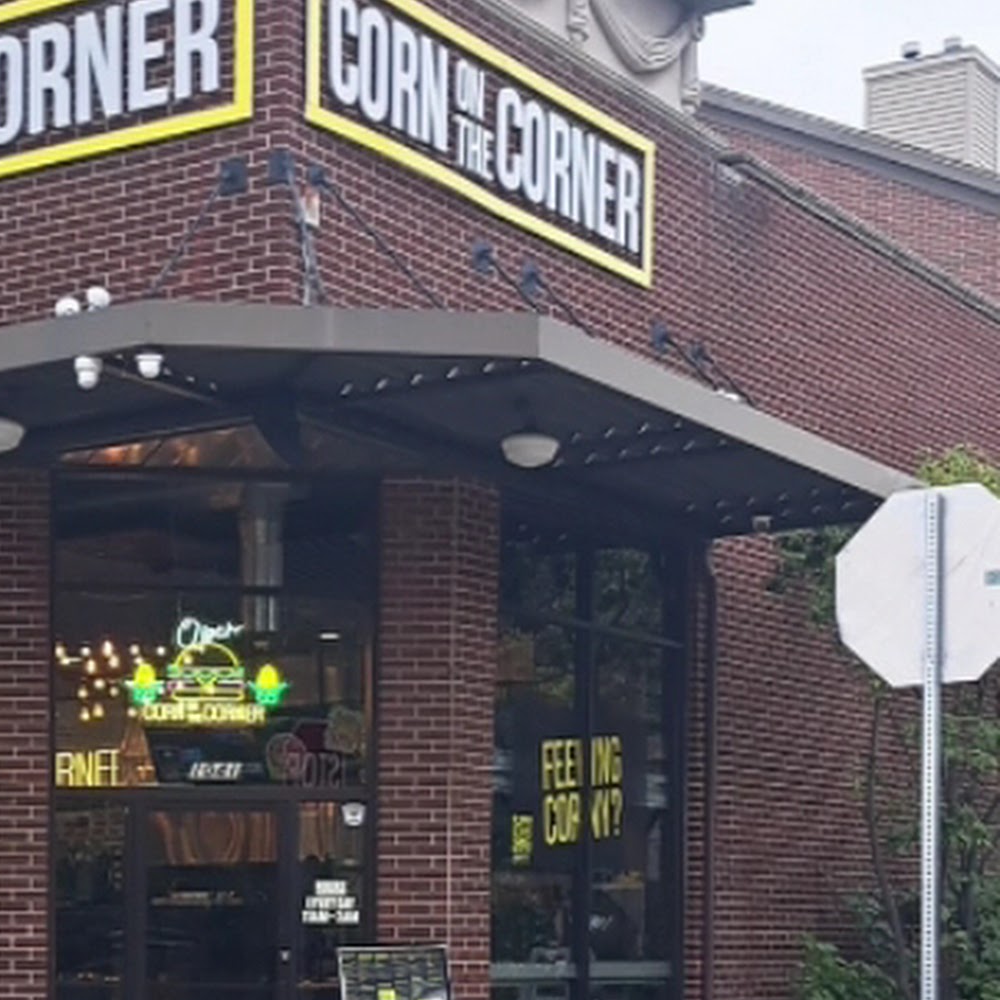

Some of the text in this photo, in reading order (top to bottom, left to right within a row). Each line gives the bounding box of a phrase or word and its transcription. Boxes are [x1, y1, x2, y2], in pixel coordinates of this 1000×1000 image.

[328, 0, 449, 152] CORN
[455, 59, 485, 121] ON
[454, 113, 496, 181] THE
[499, 87, 641, 253] CORNER
